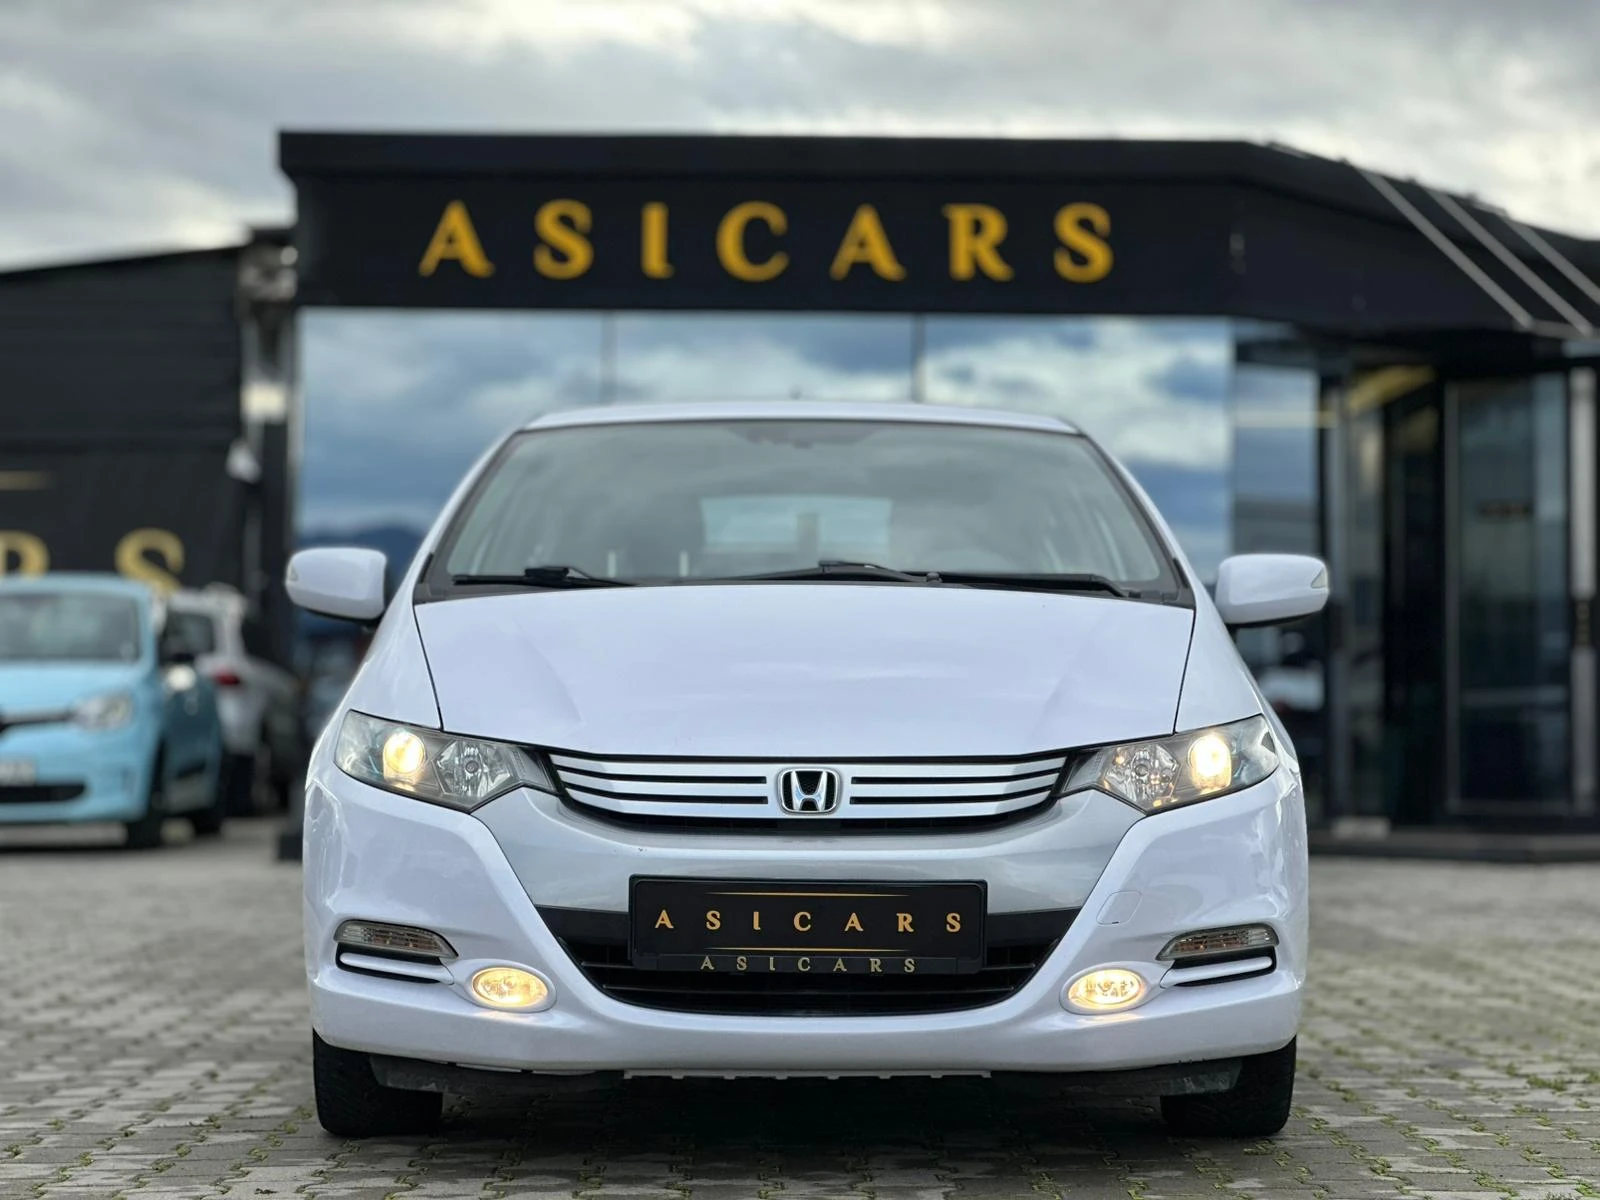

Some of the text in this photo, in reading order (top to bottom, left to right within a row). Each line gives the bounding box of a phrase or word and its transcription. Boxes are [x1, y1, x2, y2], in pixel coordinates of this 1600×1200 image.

[419, 199, 1114, 284] ASICARS
[654, 909, 962, 934] ASICARS
[700, 955, 916, 973] ASICARS
